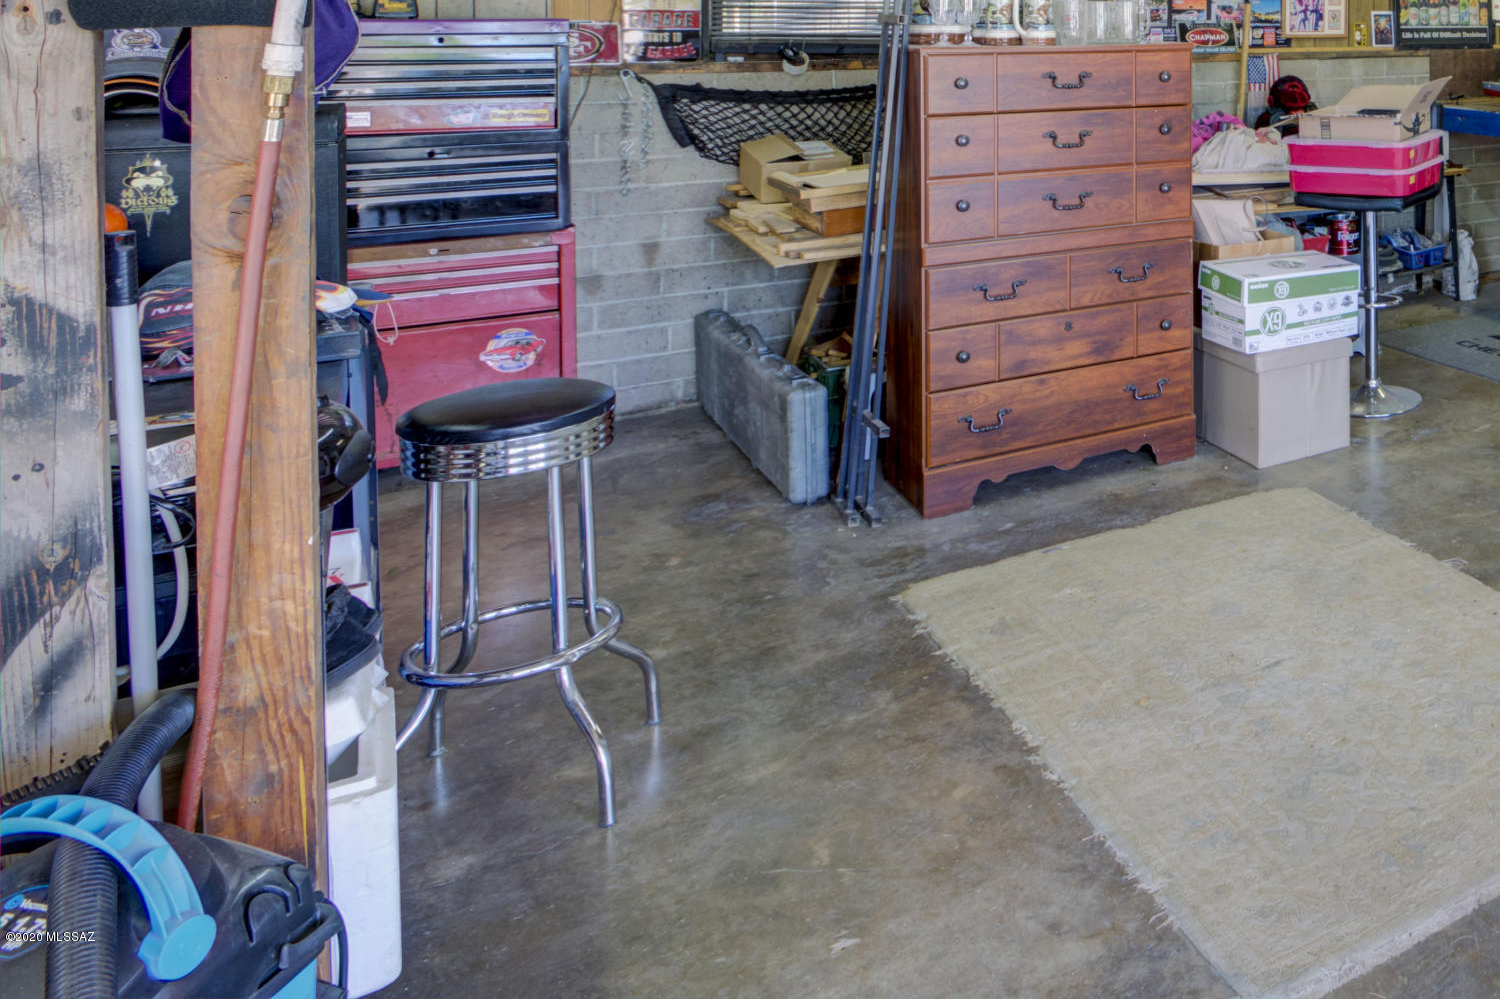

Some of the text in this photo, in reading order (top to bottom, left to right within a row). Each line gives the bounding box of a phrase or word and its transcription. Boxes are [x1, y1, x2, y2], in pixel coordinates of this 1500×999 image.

[628, 11, 694, 28] GARAGE
[1189, 33, 1227, 41] CHAPMAN
[1264, 311, 1282, 332] X9
